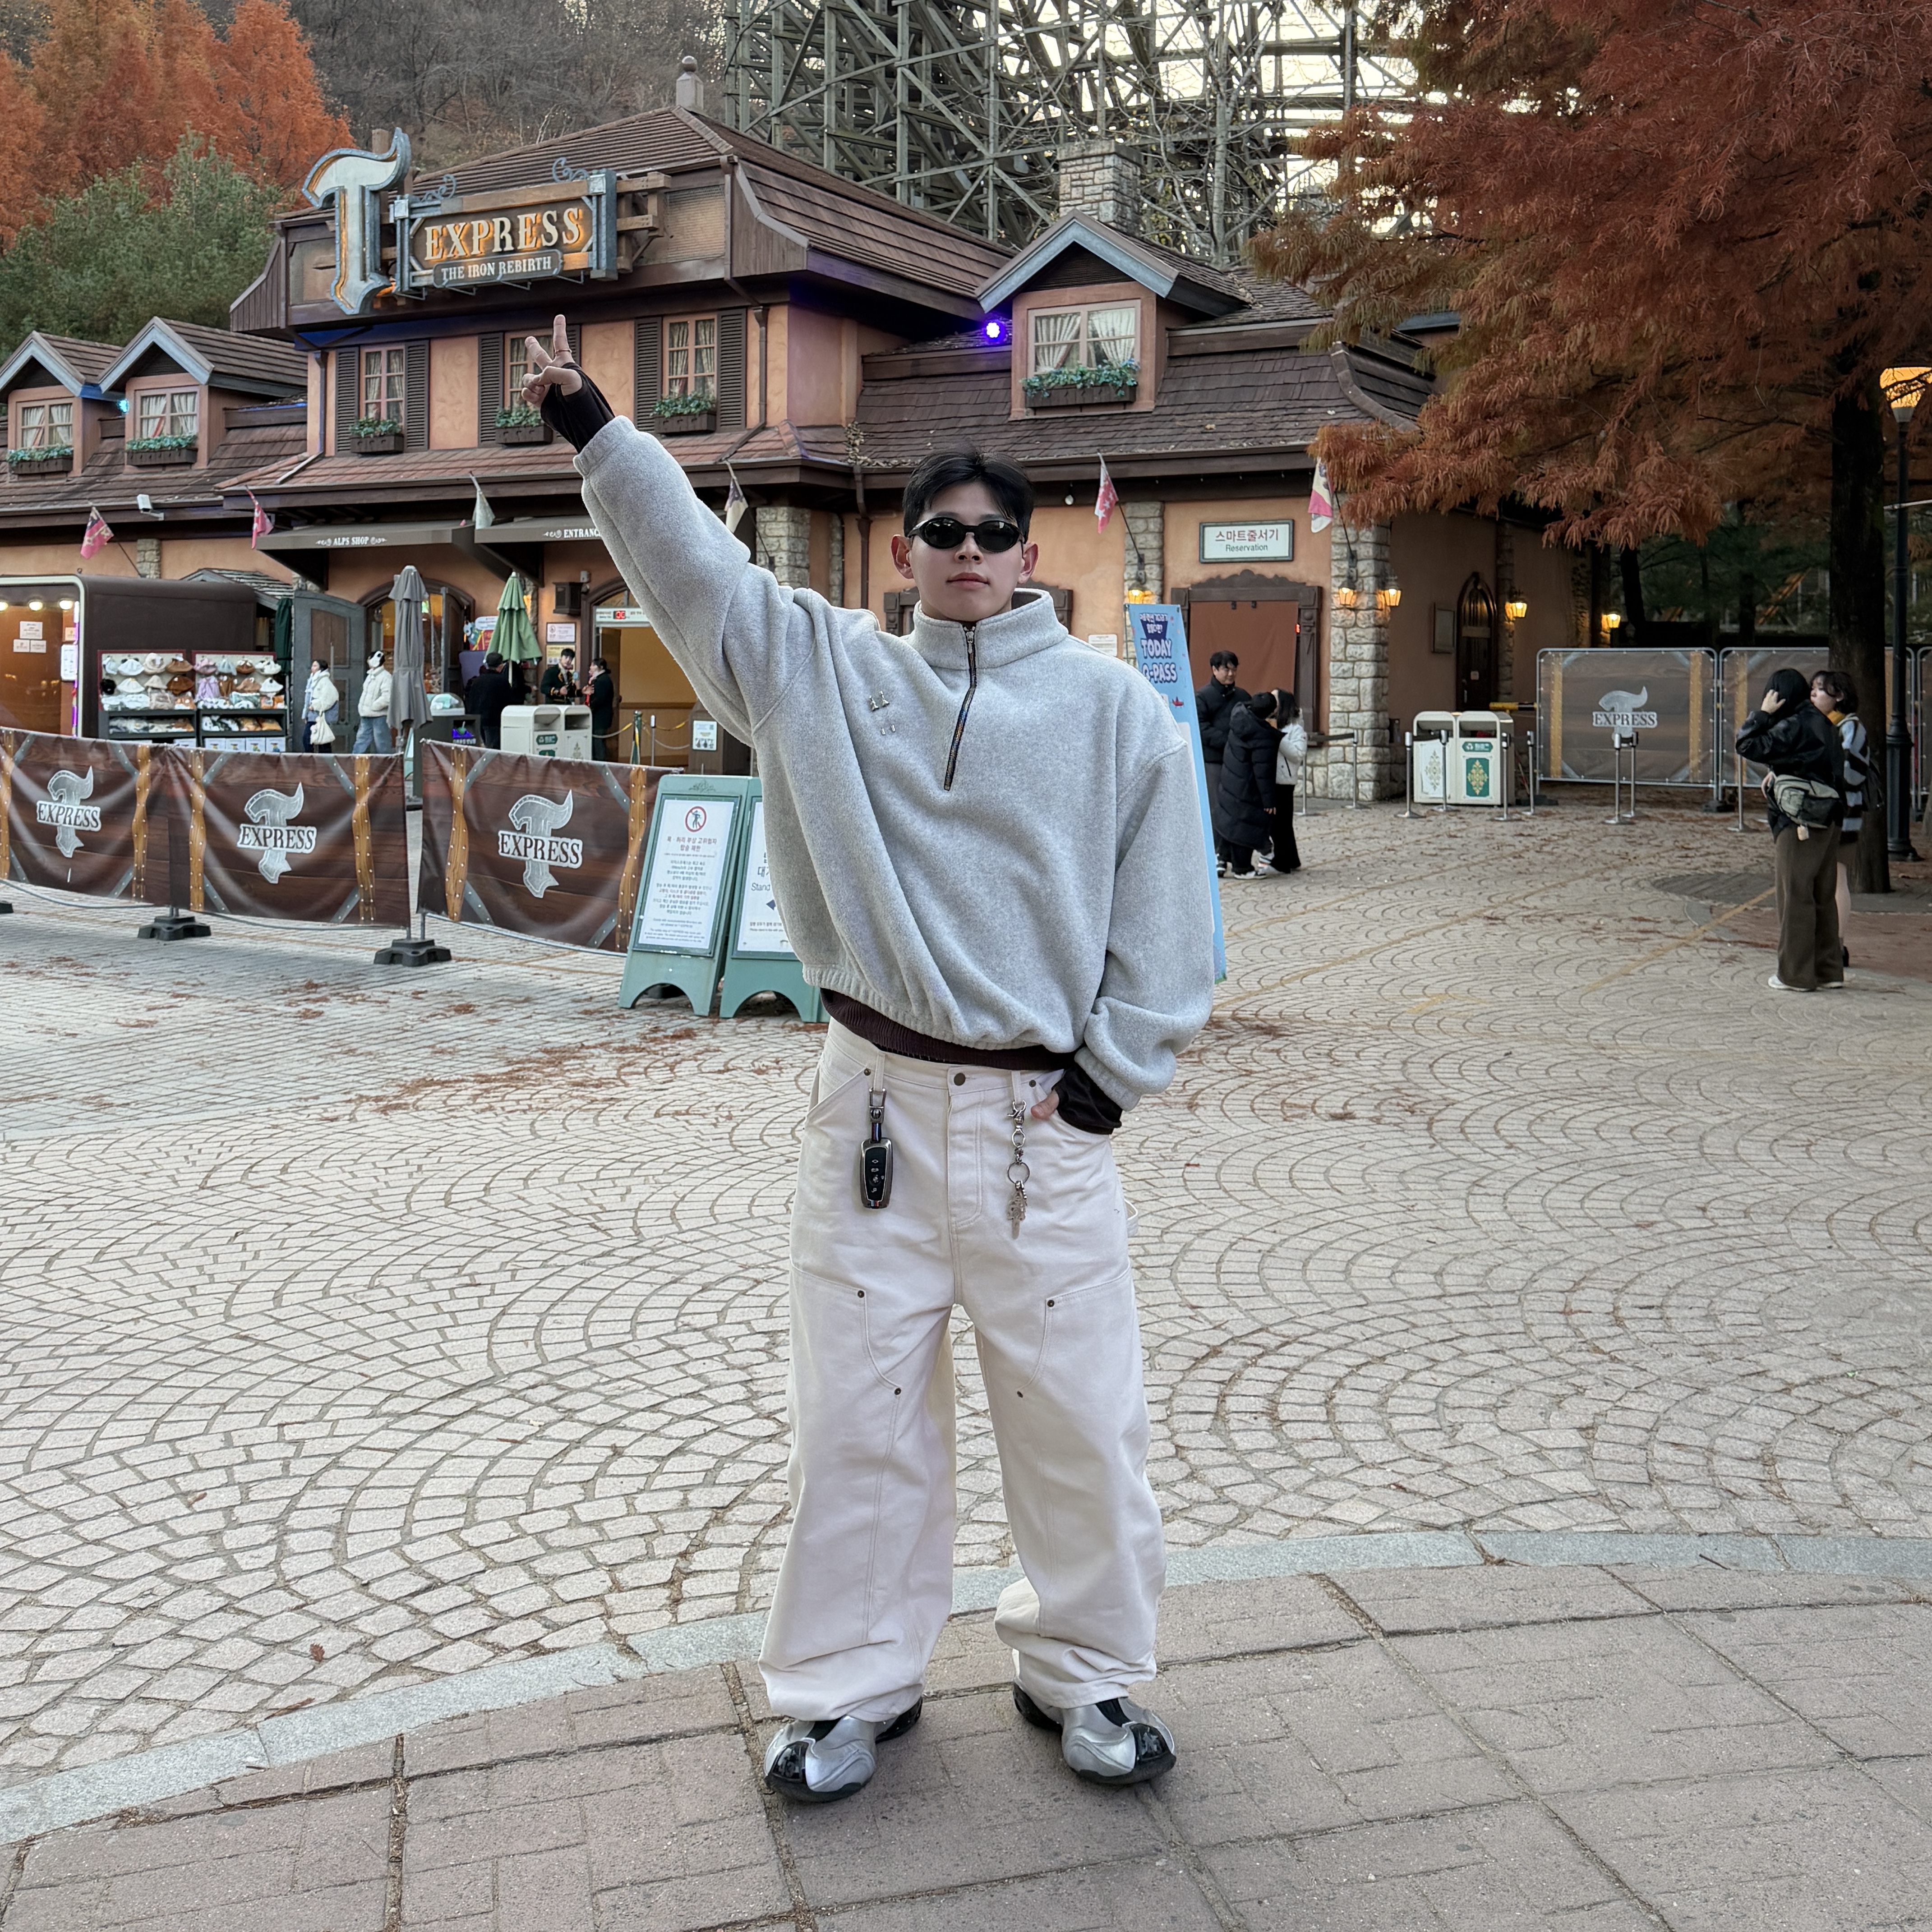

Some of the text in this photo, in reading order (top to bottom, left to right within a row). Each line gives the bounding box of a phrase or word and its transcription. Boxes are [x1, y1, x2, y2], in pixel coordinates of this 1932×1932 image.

[424, 208, 580, 260] EXPRESS
[441, 256, 551, 281] THE IRON REBIRTH
[333, 536, 369, 546] ALPS SHOP
[564, 529, 600, 538] ENTRANC
[1215, 529, 1278, 542] 스마트줄서기
[1226, 544, 1268, 552] Reservation
[1141, 638, 1172, 658] TODAY
[1142, 663, 1177, 683] Q-PASS
[1595, 713, 1655, 726] EXPRESS
[38, 803, 99, 828] EXPRESS
[240, 826, 314, 850] EXPRESS
[500, 833, 579, 865] EXPRESS
